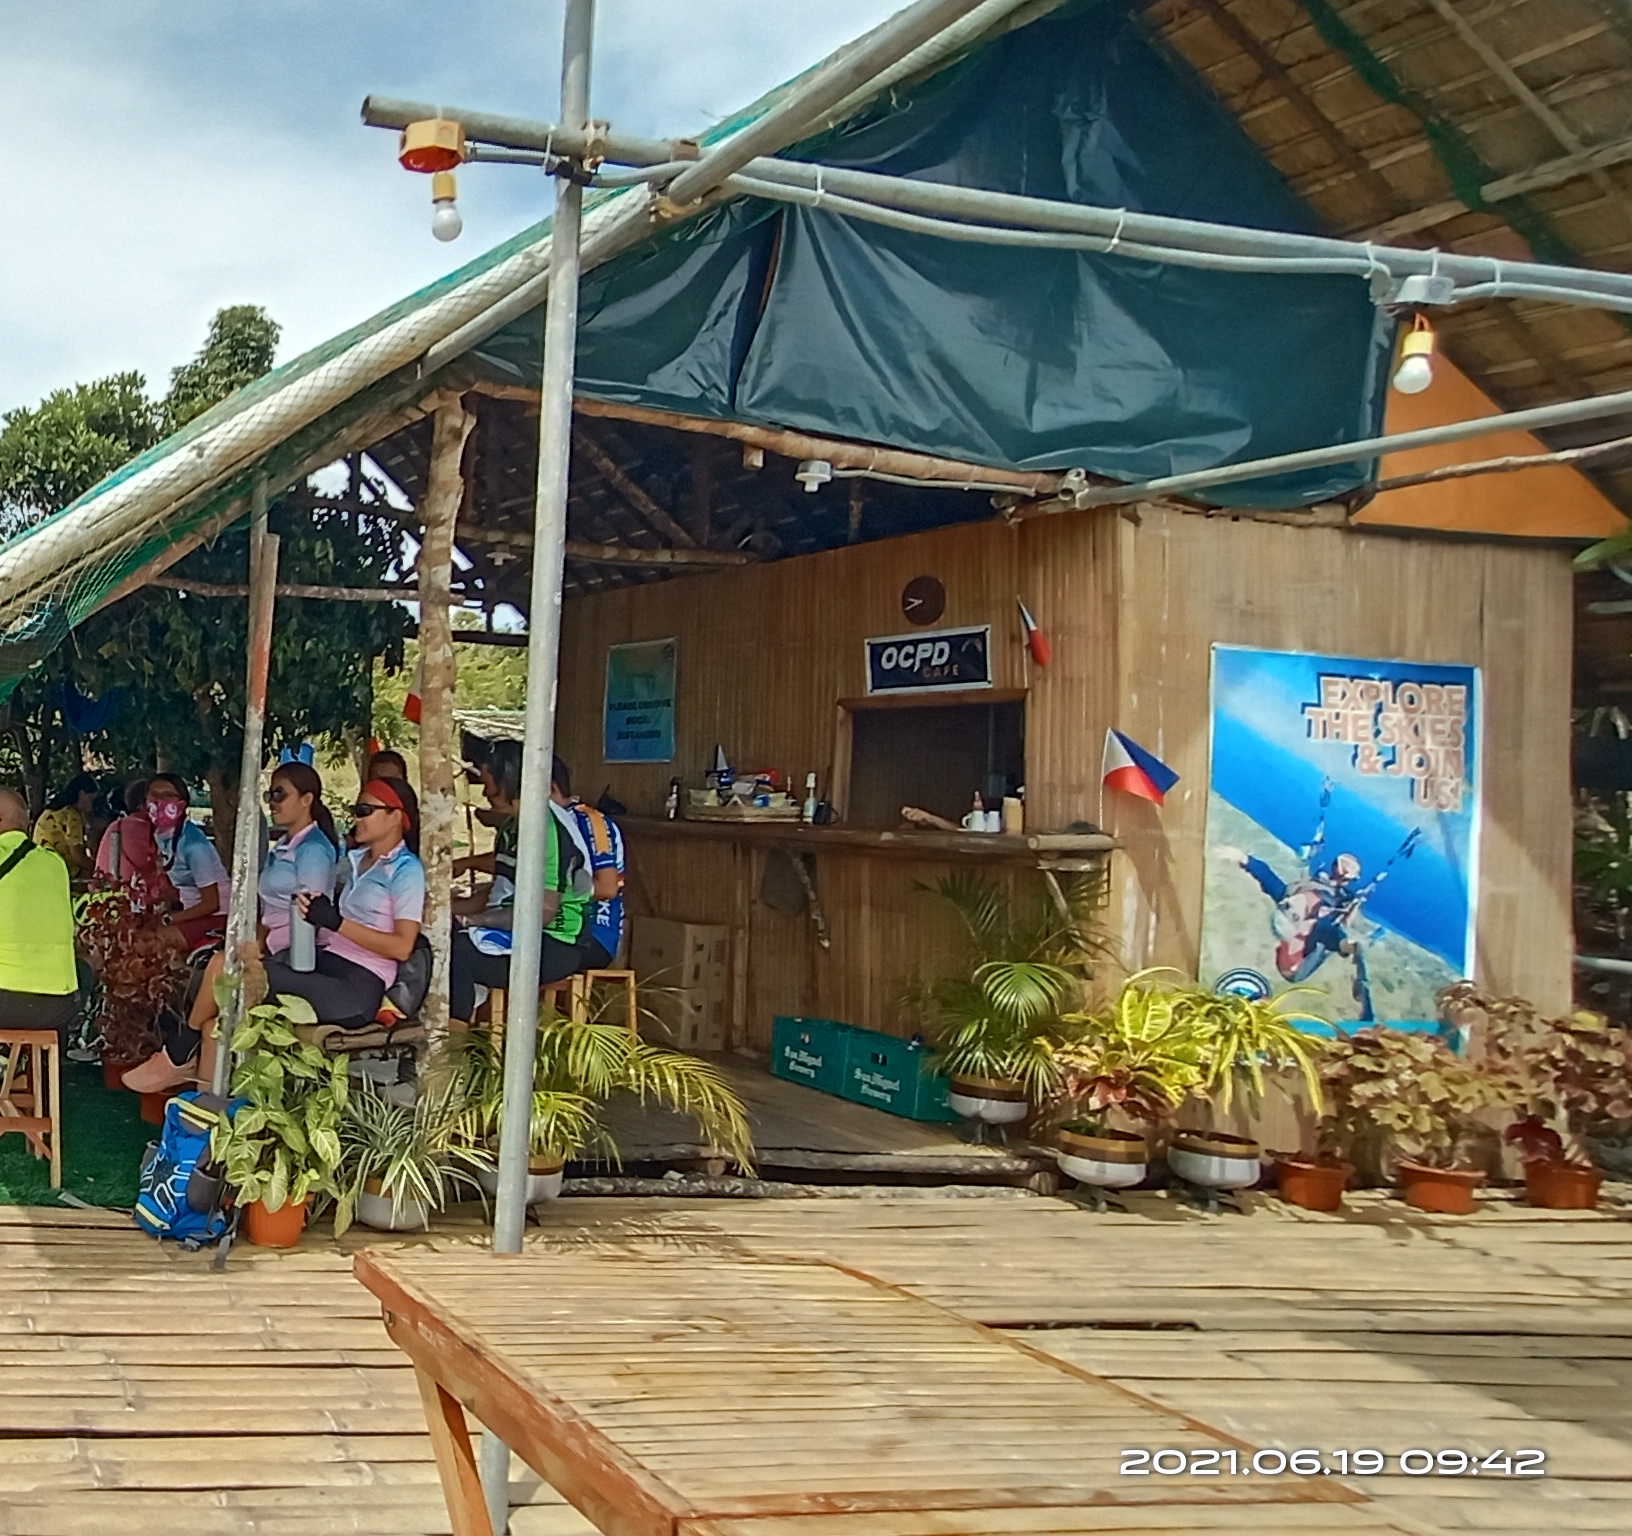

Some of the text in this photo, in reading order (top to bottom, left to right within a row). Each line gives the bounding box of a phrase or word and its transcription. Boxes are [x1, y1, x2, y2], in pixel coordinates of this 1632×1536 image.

[880, 641, 950, 673] OCPD
[922, 664, 959, 678] CAFE
[1319, 676, 1467, 717] EXPLORE
[1305, 707, 1465, 750] THE SKIES
[1357, 744, 1464, 779] & JOIN
[1415, 776, 1464, 813] US!
